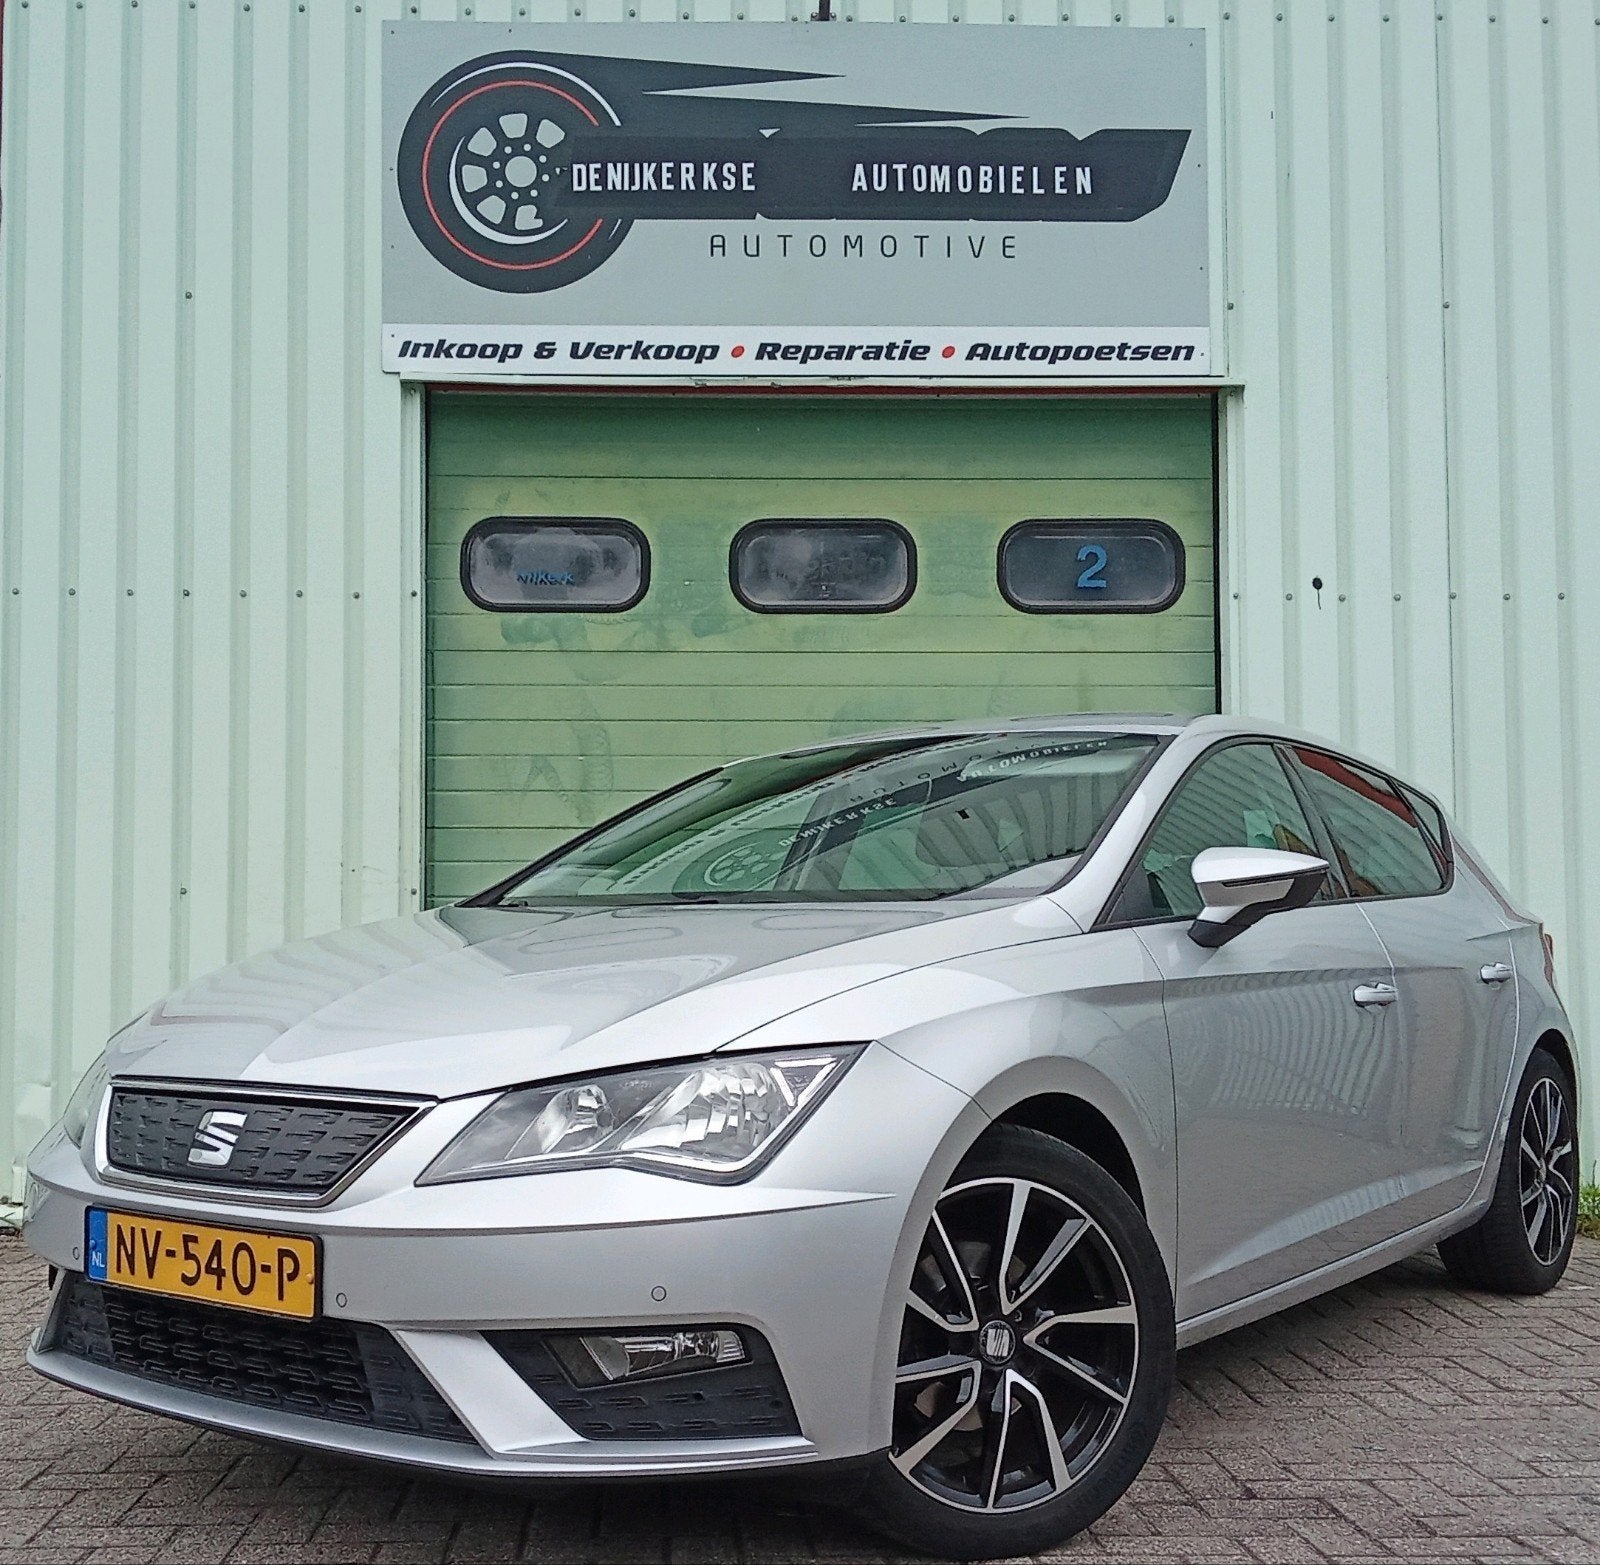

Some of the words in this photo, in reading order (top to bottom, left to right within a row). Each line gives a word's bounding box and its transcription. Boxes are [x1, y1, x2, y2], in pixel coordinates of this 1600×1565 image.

[572, 162, 756, 192] DENIJKERKSE
[851, 163, 1092, 195] AUTOMOBIELEN
[709, 234, 1016, 258] AUTOMOTIVE
[398, 339, 524, 364] Inkoop
[533, 341, 558, 359] &
[569, 340, 720, 364] Verkoop
[754, 340, 932, 365] Reparatie
[964, 341, 1196, 365] Autopoetsen
[1077, 544, 1107, 588] 2
[91, 1251, 106, 1268] NL
[115, 1223, 300, 1302] NV-540-P
